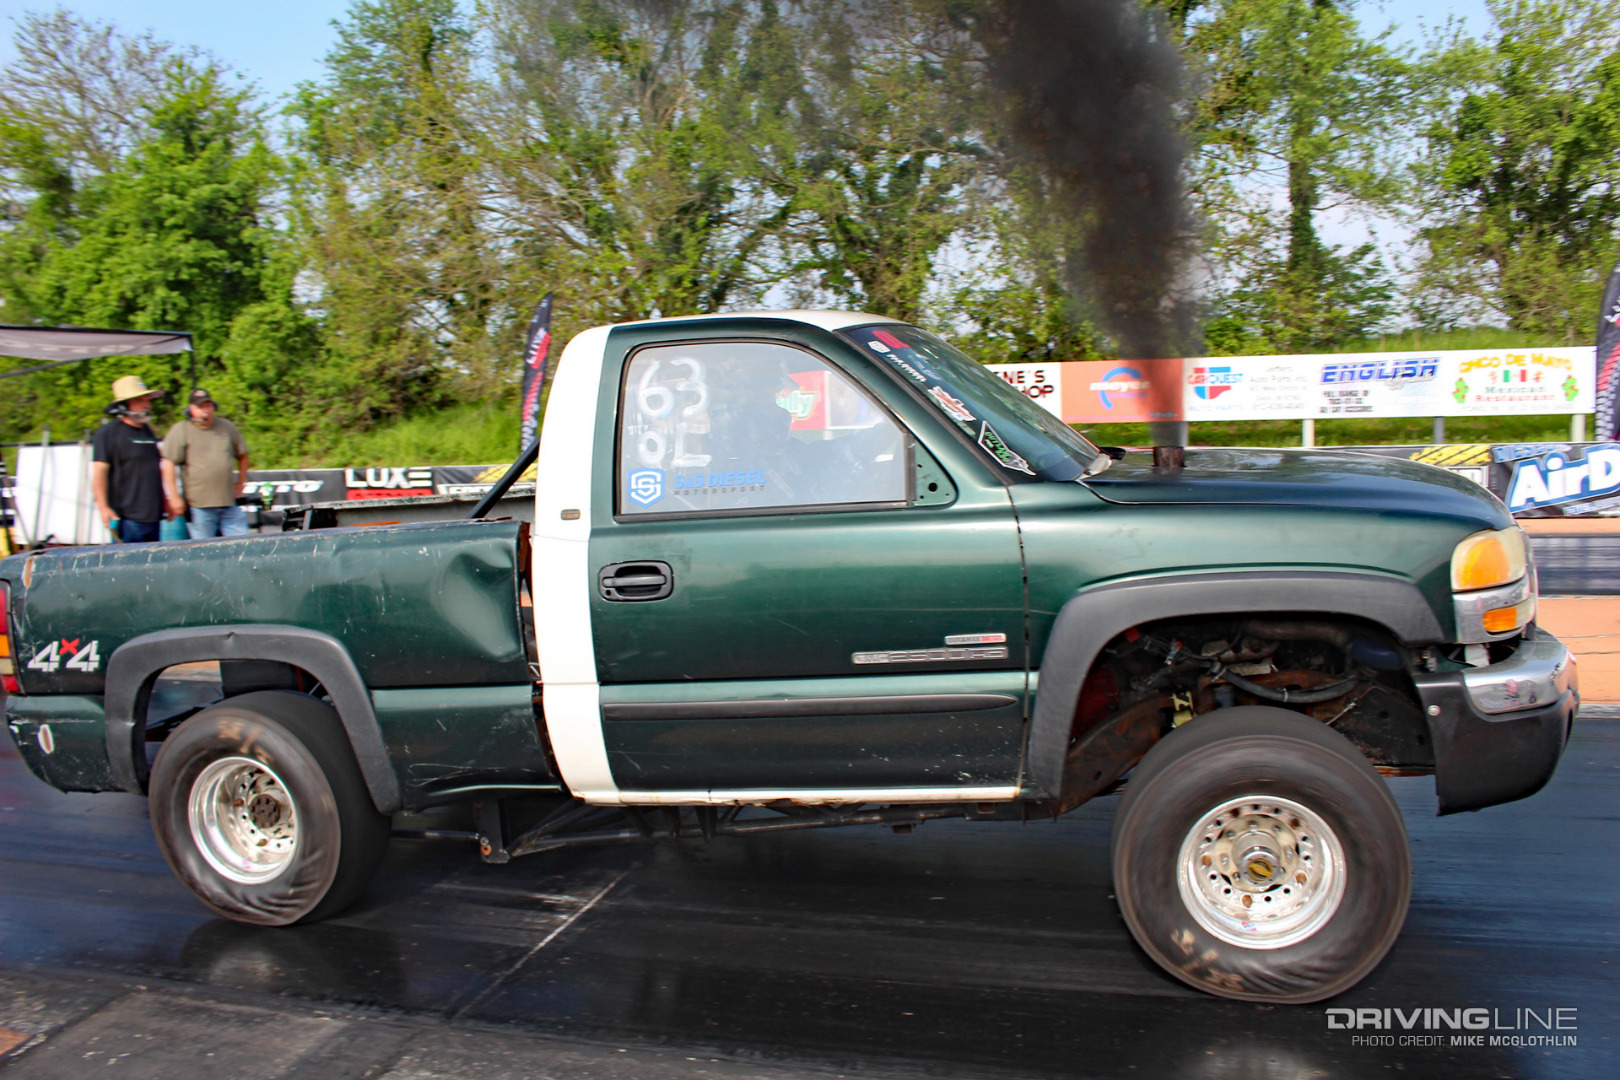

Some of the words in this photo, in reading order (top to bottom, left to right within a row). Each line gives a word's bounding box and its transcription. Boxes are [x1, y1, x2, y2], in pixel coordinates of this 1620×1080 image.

[1505, 354, 1526, 366] DE
[993, 370, 1045, 384] NE'S
[1321, 358, 1440, 383] ENGLISH
[1187, 373, 1244, 385] CARQUEST
[637, 357, 707, 417] 63
[1017, 385, 1055, 399] HOP
[1089, 381, 1149, 392] meyer
[1475, 394, 1556, 402] Restaurant
[347, 467, 432, 488] LUXE
[674, 474, 704, 489] S&S
[707, 470, 767, 487] DIESEL
[1508, 446, 1620, 508] AirD
[674, 484, 765, 495] MOTORSPORT
